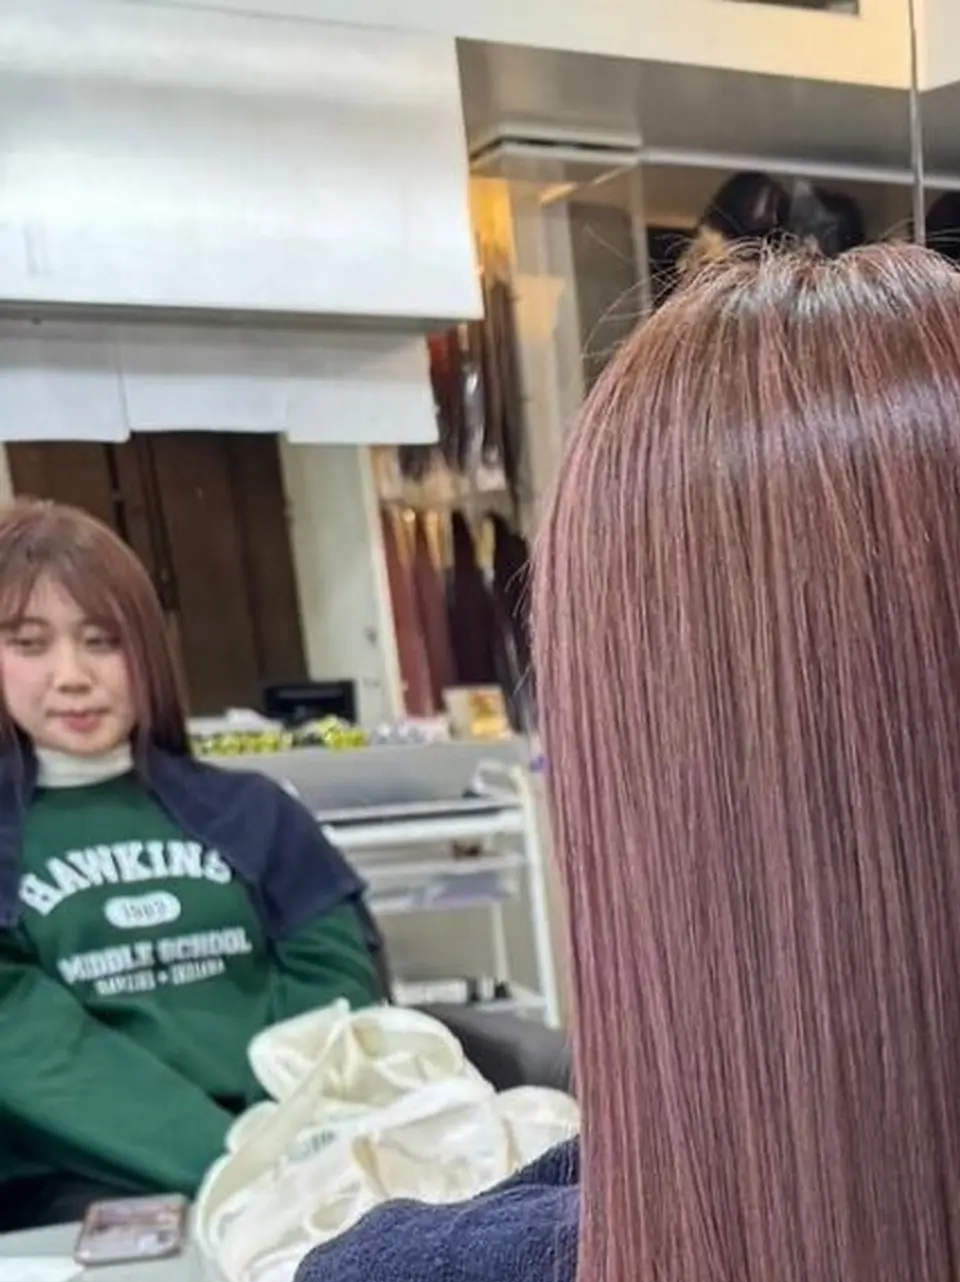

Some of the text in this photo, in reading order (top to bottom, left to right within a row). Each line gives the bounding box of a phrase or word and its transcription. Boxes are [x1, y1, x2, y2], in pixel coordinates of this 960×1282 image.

[18, 839, 232, 916] HAWKINS
[57, 926, 252, 985] MIDDLE SCHOOL
